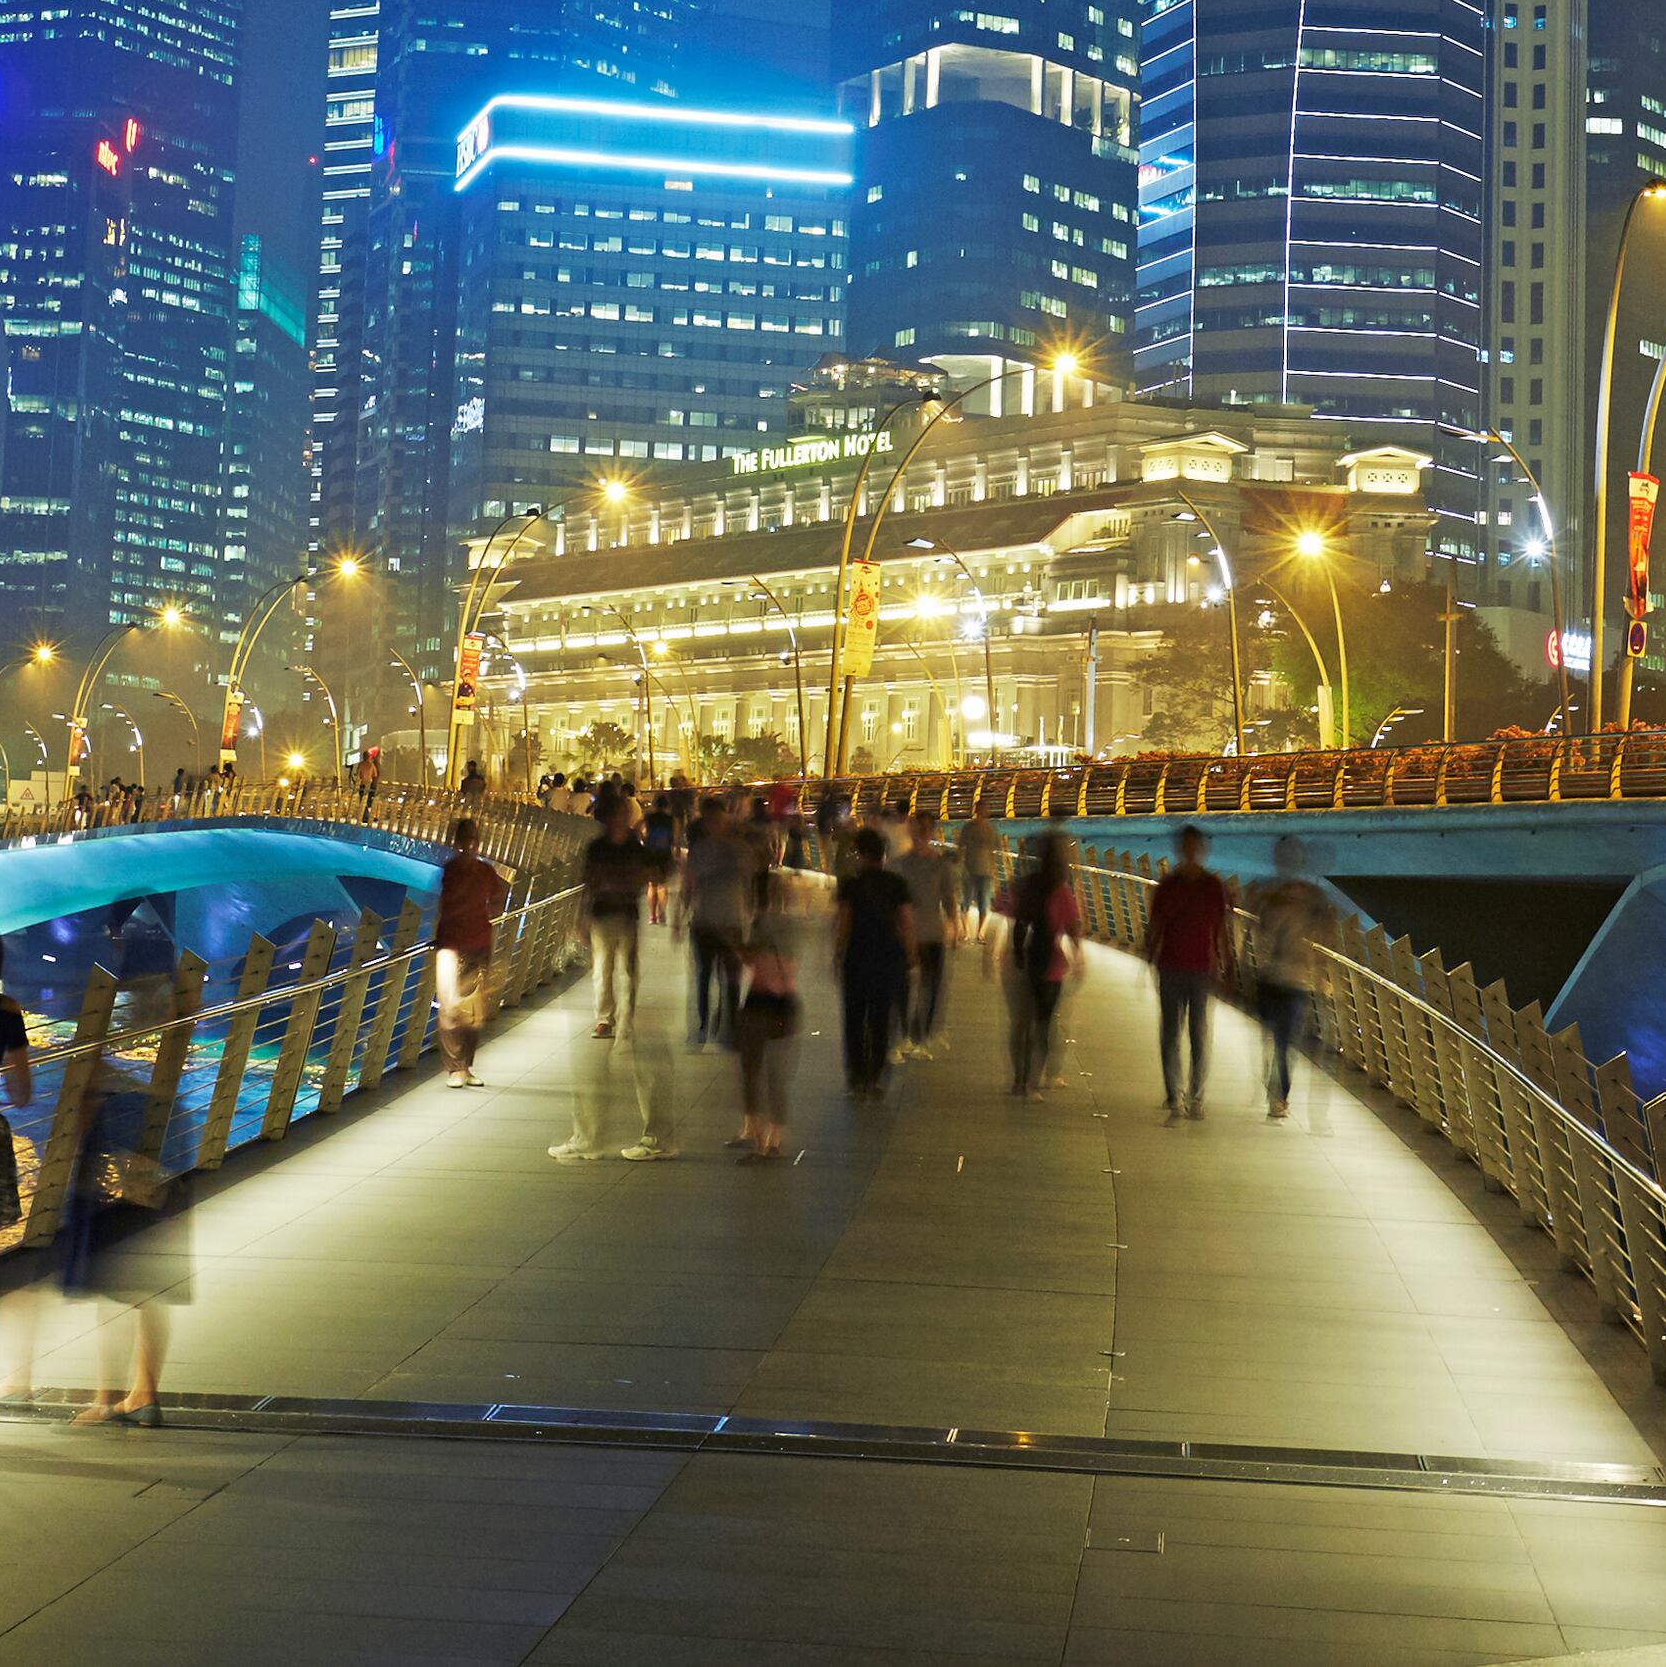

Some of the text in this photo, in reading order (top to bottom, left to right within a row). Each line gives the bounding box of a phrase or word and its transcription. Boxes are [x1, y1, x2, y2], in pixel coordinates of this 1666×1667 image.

[732, 430, 894, 475] THE FULLERTON HOTEL
